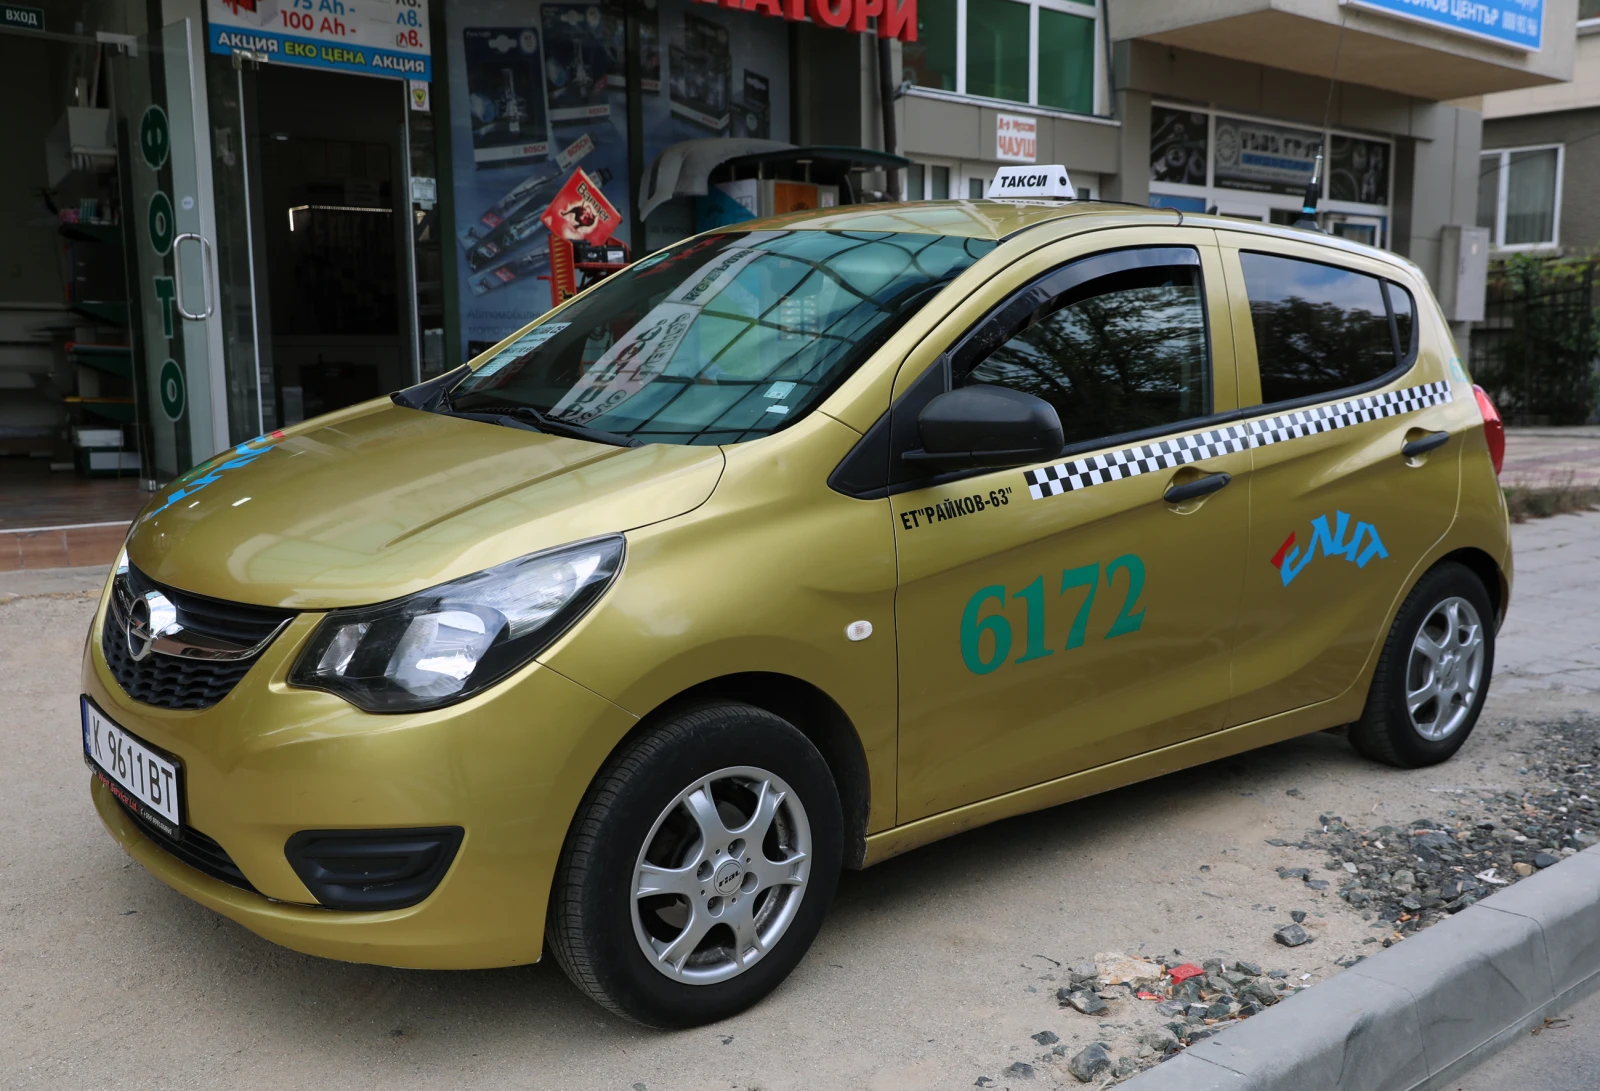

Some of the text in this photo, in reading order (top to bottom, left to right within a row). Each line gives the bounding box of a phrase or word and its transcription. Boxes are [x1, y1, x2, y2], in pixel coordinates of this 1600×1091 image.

[6, 8, 37, 26] ВХОД
[319, 0, 345, 15] Ah
[1450, 1, 1499, 26] ЦЕНТЪР
[281, 10, 314, 31] 100
[320, 17, 345, 36] Ah
[218, 32, 425, 73] АКЦИЯ ЕКО ЦЕНА АКЦИЯ
[523, 145, 547, 155] BOSCH
[567, 136, 589, 157] BOSCH
[999, 136, 1036, 157] ЧАУШ
[1001, 175, 1048, 188] ТАКСИ
[576, 183, 611, 222] Banner
[140, 104, 185, 421] ФОТО
[960, 553, 1147, 675] 6172
